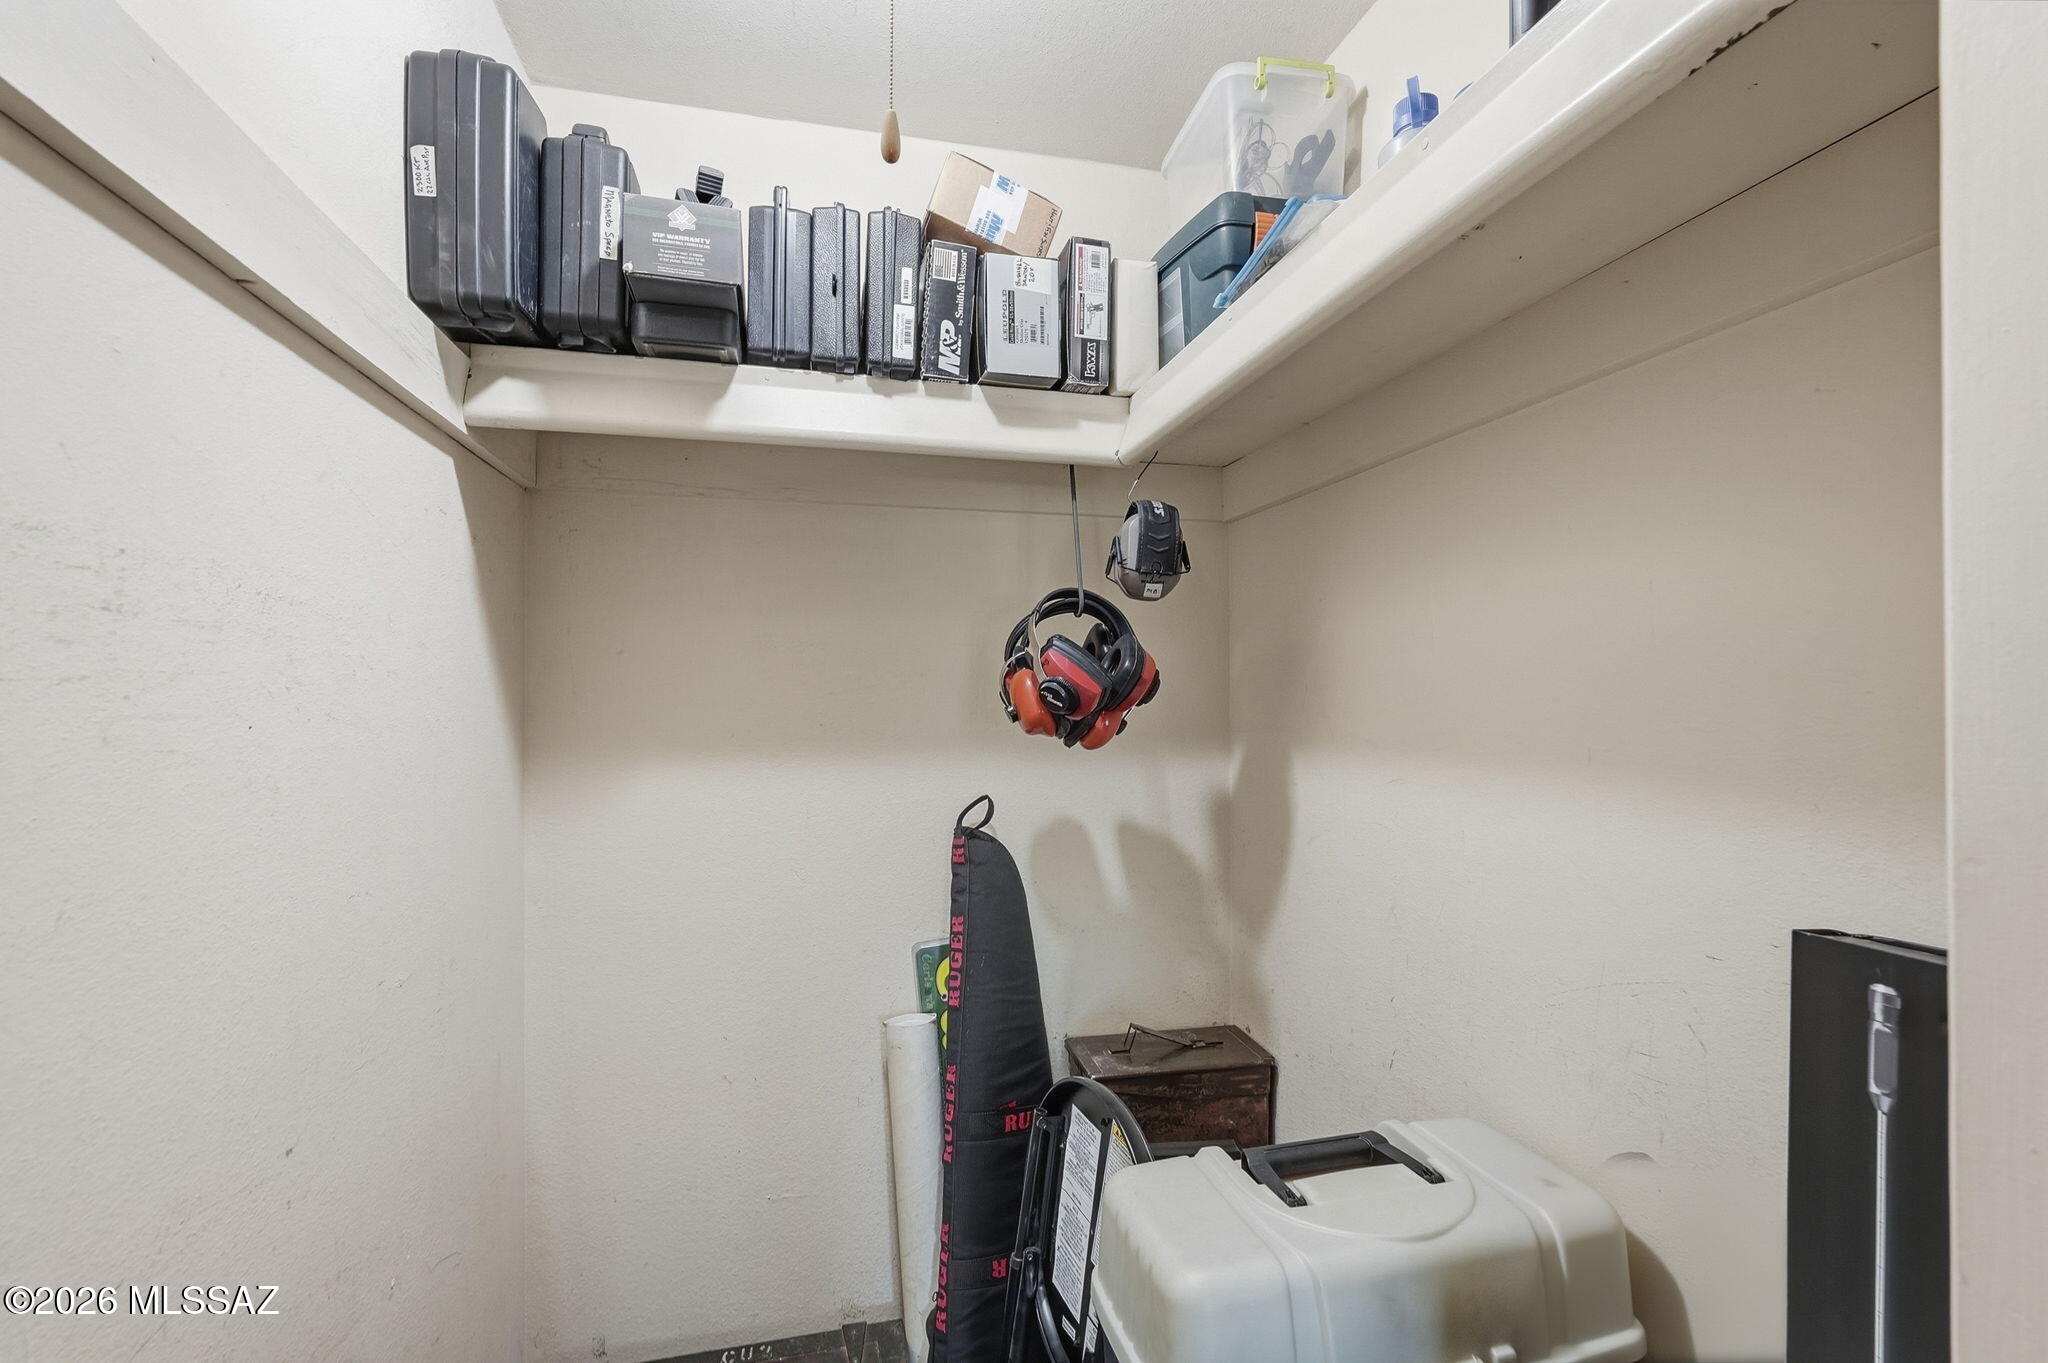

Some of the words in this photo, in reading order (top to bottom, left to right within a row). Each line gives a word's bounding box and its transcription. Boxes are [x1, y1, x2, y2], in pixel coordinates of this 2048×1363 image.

[938, 319, 962, 376] M&P
[1084, 341, 1097, 378] KWA
[948, 915, 964, 1008] RUGER
[942, 1064, 958, 1164] RUGER
[935, 1223, 951, 1334] RUGER
